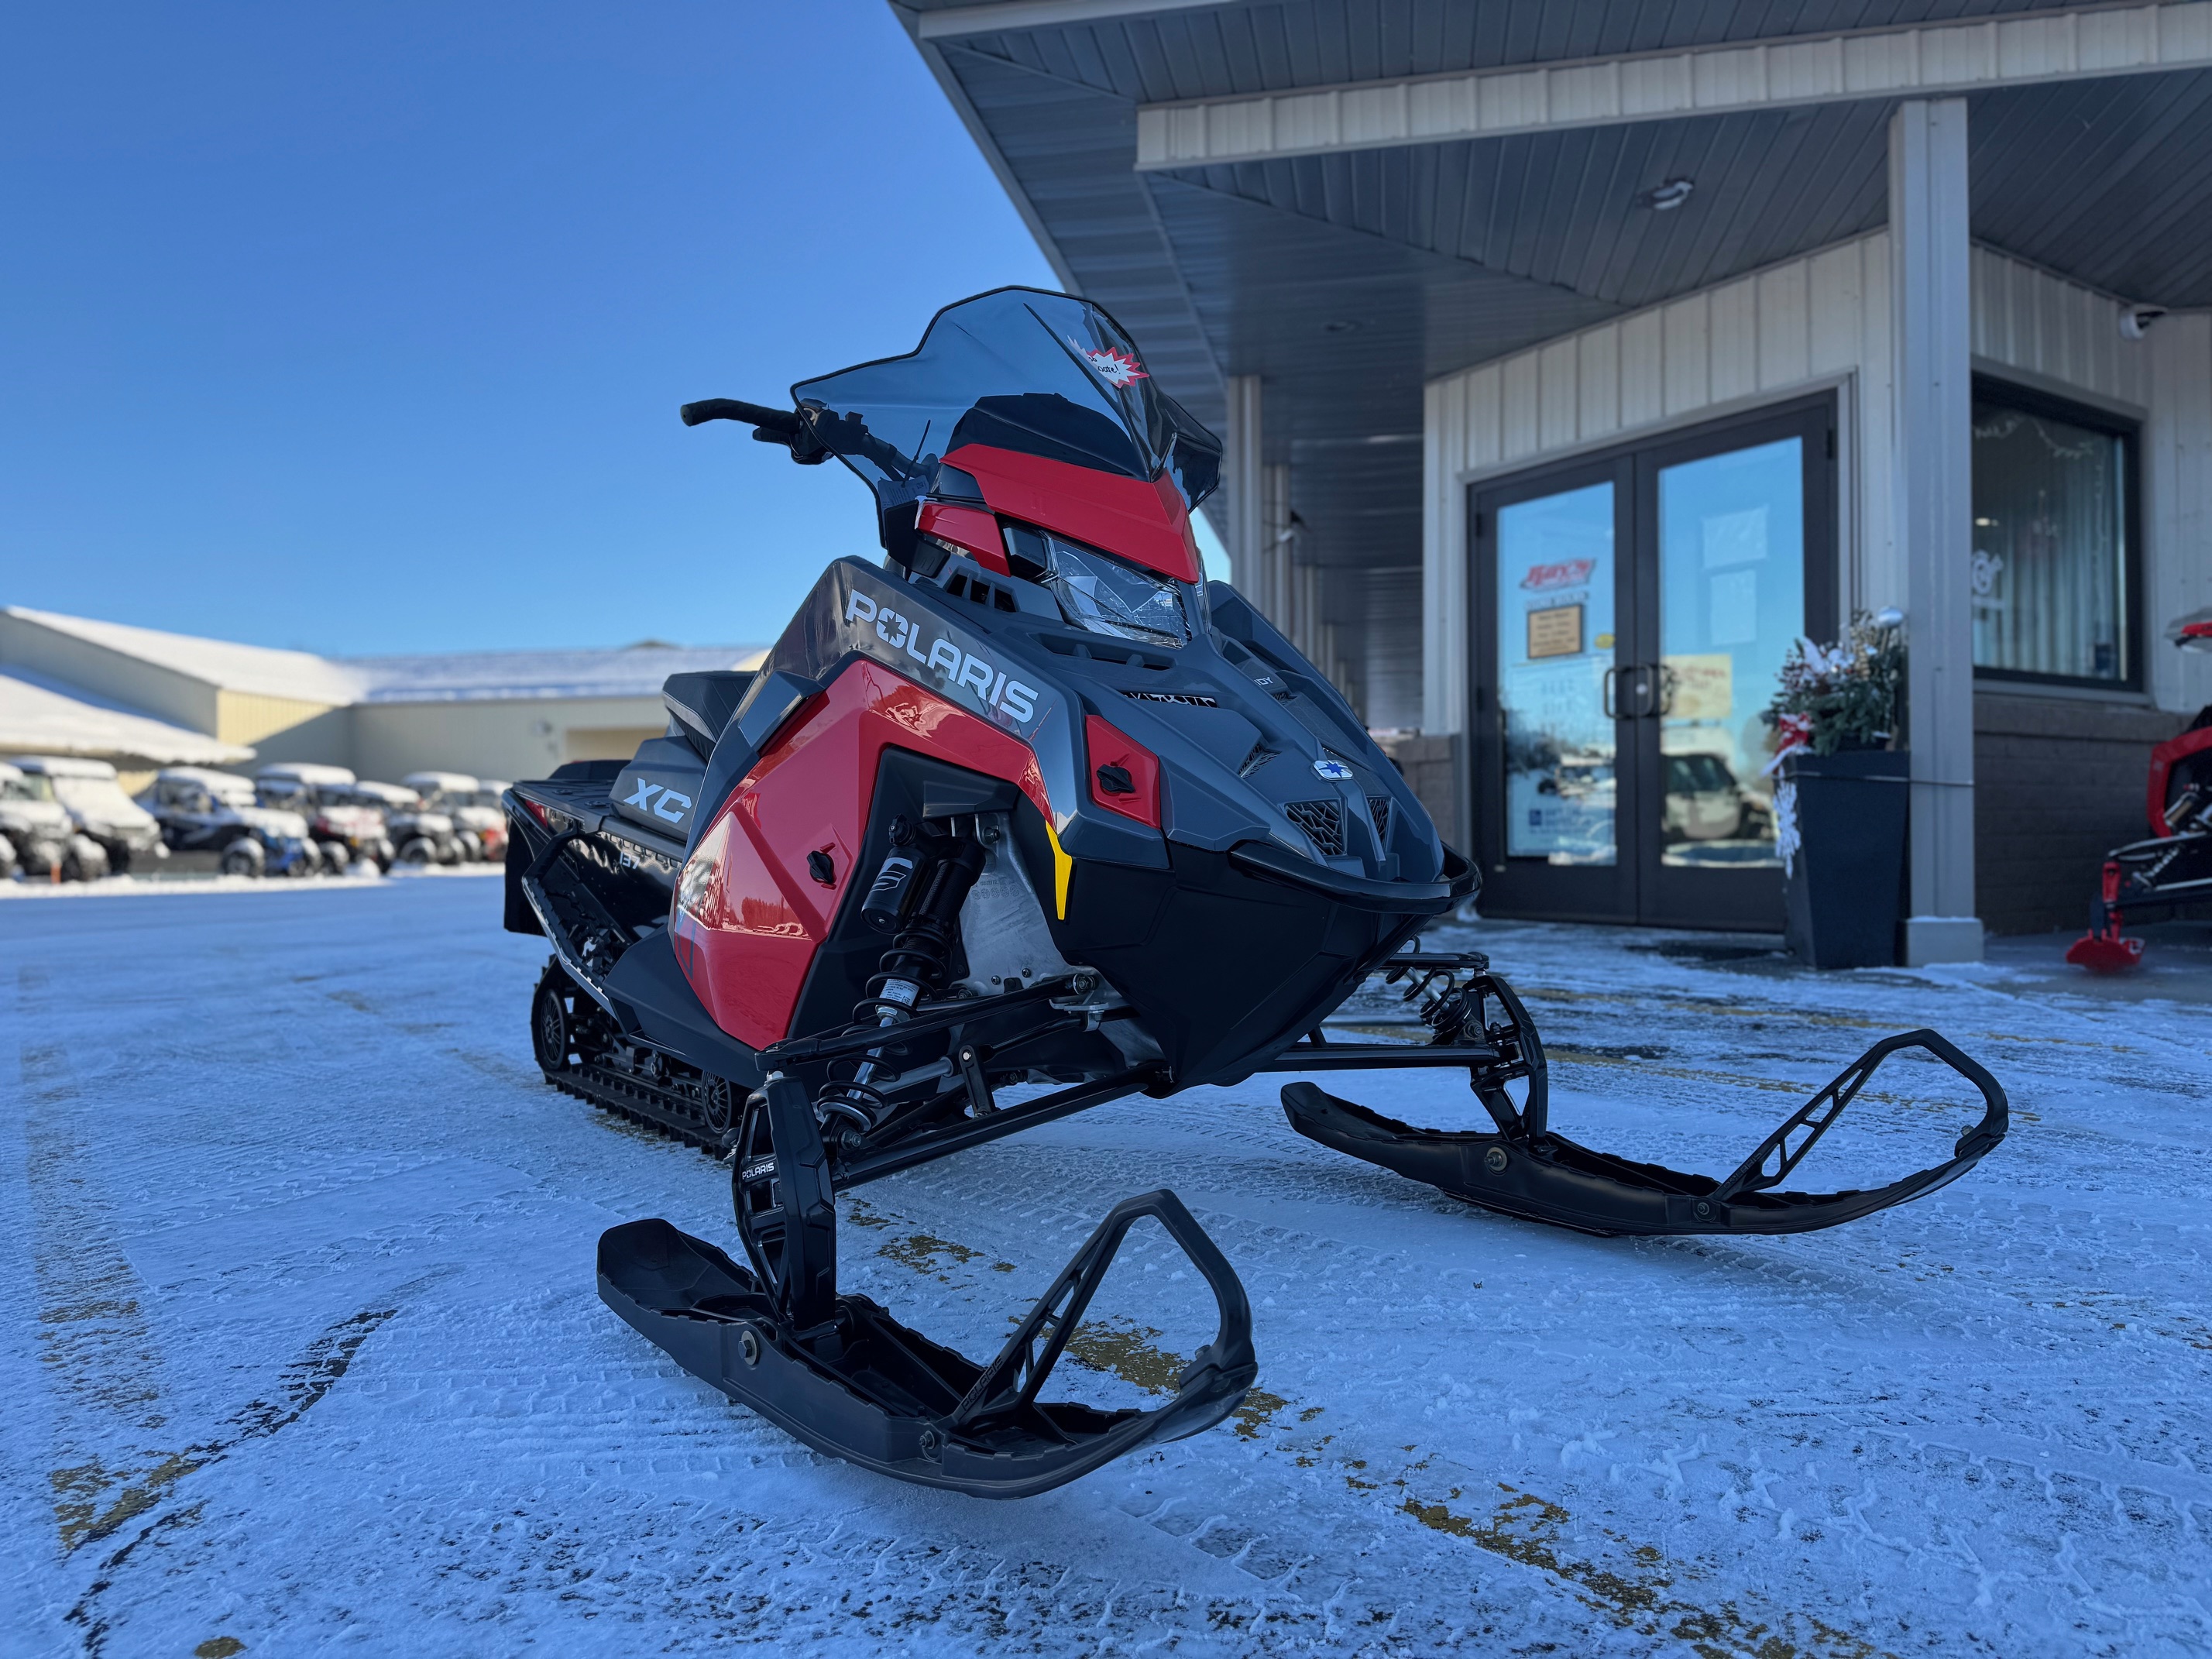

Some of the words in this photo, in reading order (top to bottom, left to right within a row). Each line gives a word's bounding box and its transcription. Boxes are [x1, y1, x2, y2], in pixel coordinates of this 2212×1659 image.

[845, 589, 1039, 724] POLARIS
[623, 778, 692, 823] XC
[620, 851, 641, 870] 137
[742, 1162, 775, 1180] POLARIS
[1723, 1152, 1763, 1189] POLARIS
[960, 1354, 1003, 1411] POLARIS
